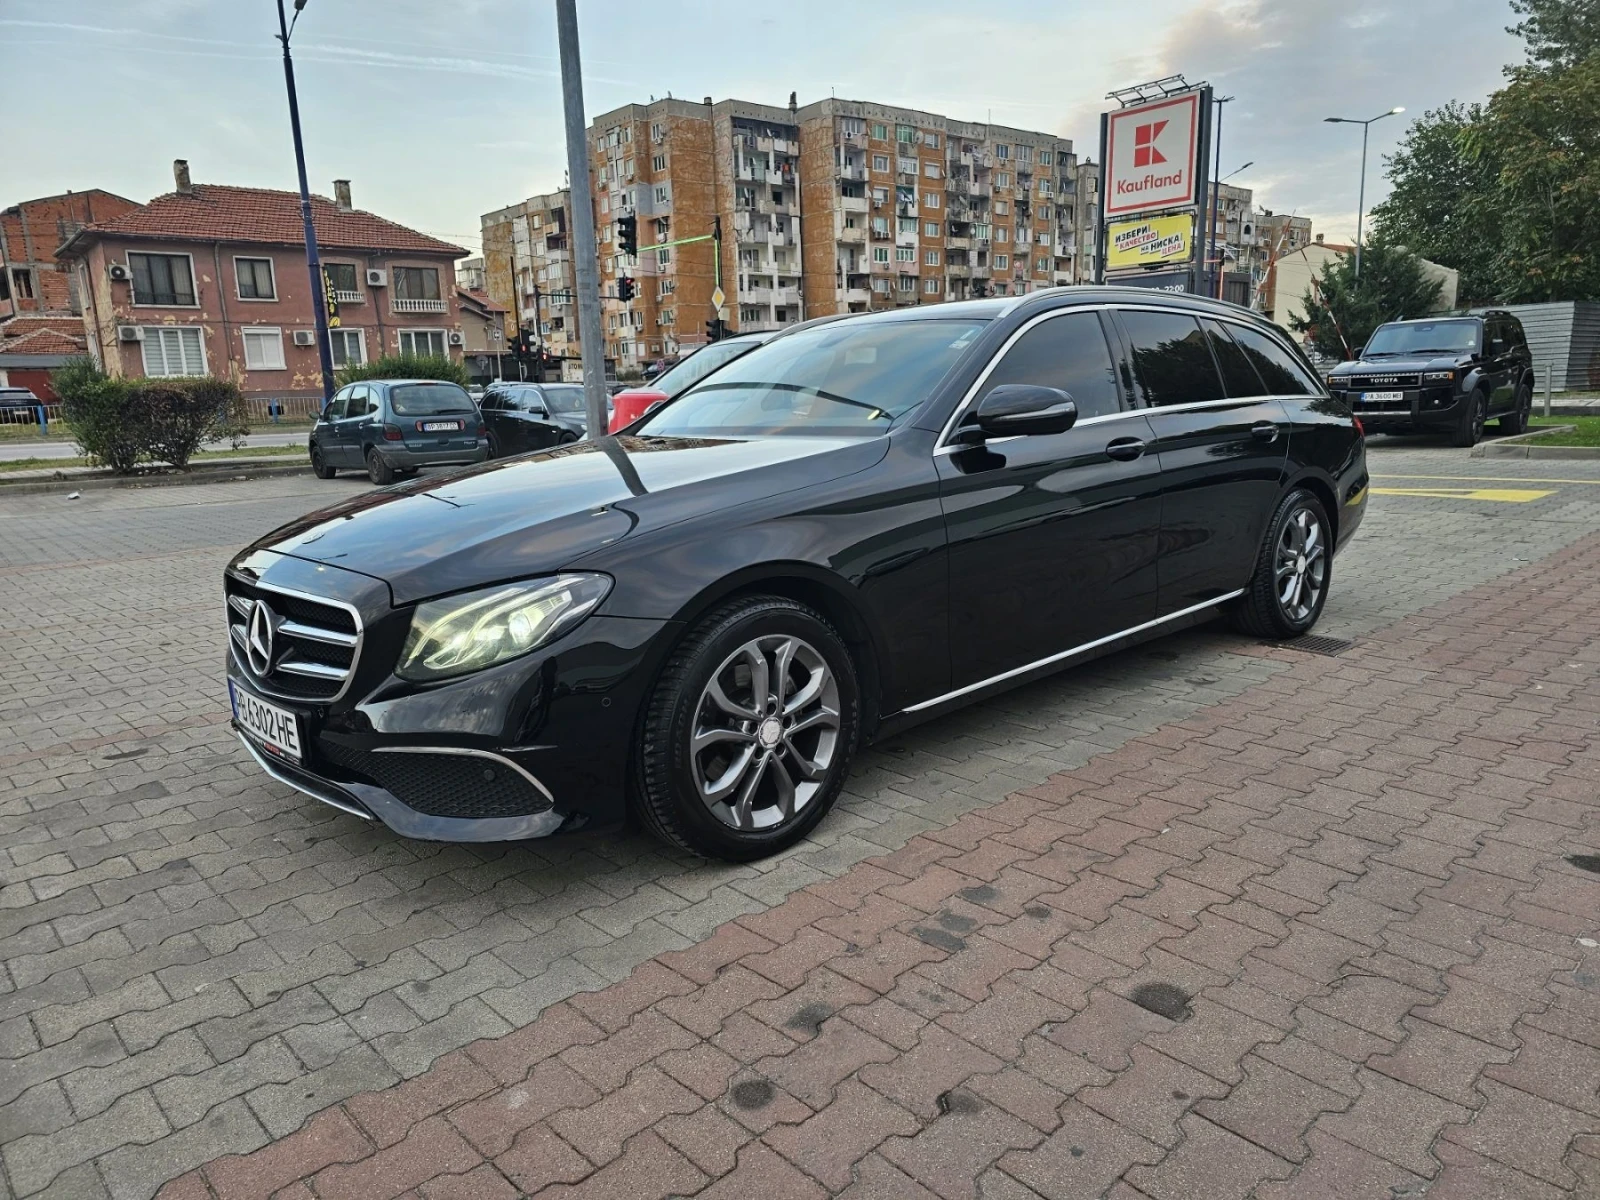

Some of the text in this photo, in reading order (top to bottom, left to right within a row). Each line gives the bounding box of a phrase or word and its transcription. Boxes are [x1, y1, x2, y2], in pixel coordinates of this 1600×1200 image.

[1117, 170, 1182, 194] Kaufland
[1115, 225, 1148, 243] ИЗБЕРИ
[1119, 232, 1156, 250] КАЧЕСТВО
[1150, 234, 1180, 251] НИСКА
[1161, 244, 1182, 255] ЦЕНА
